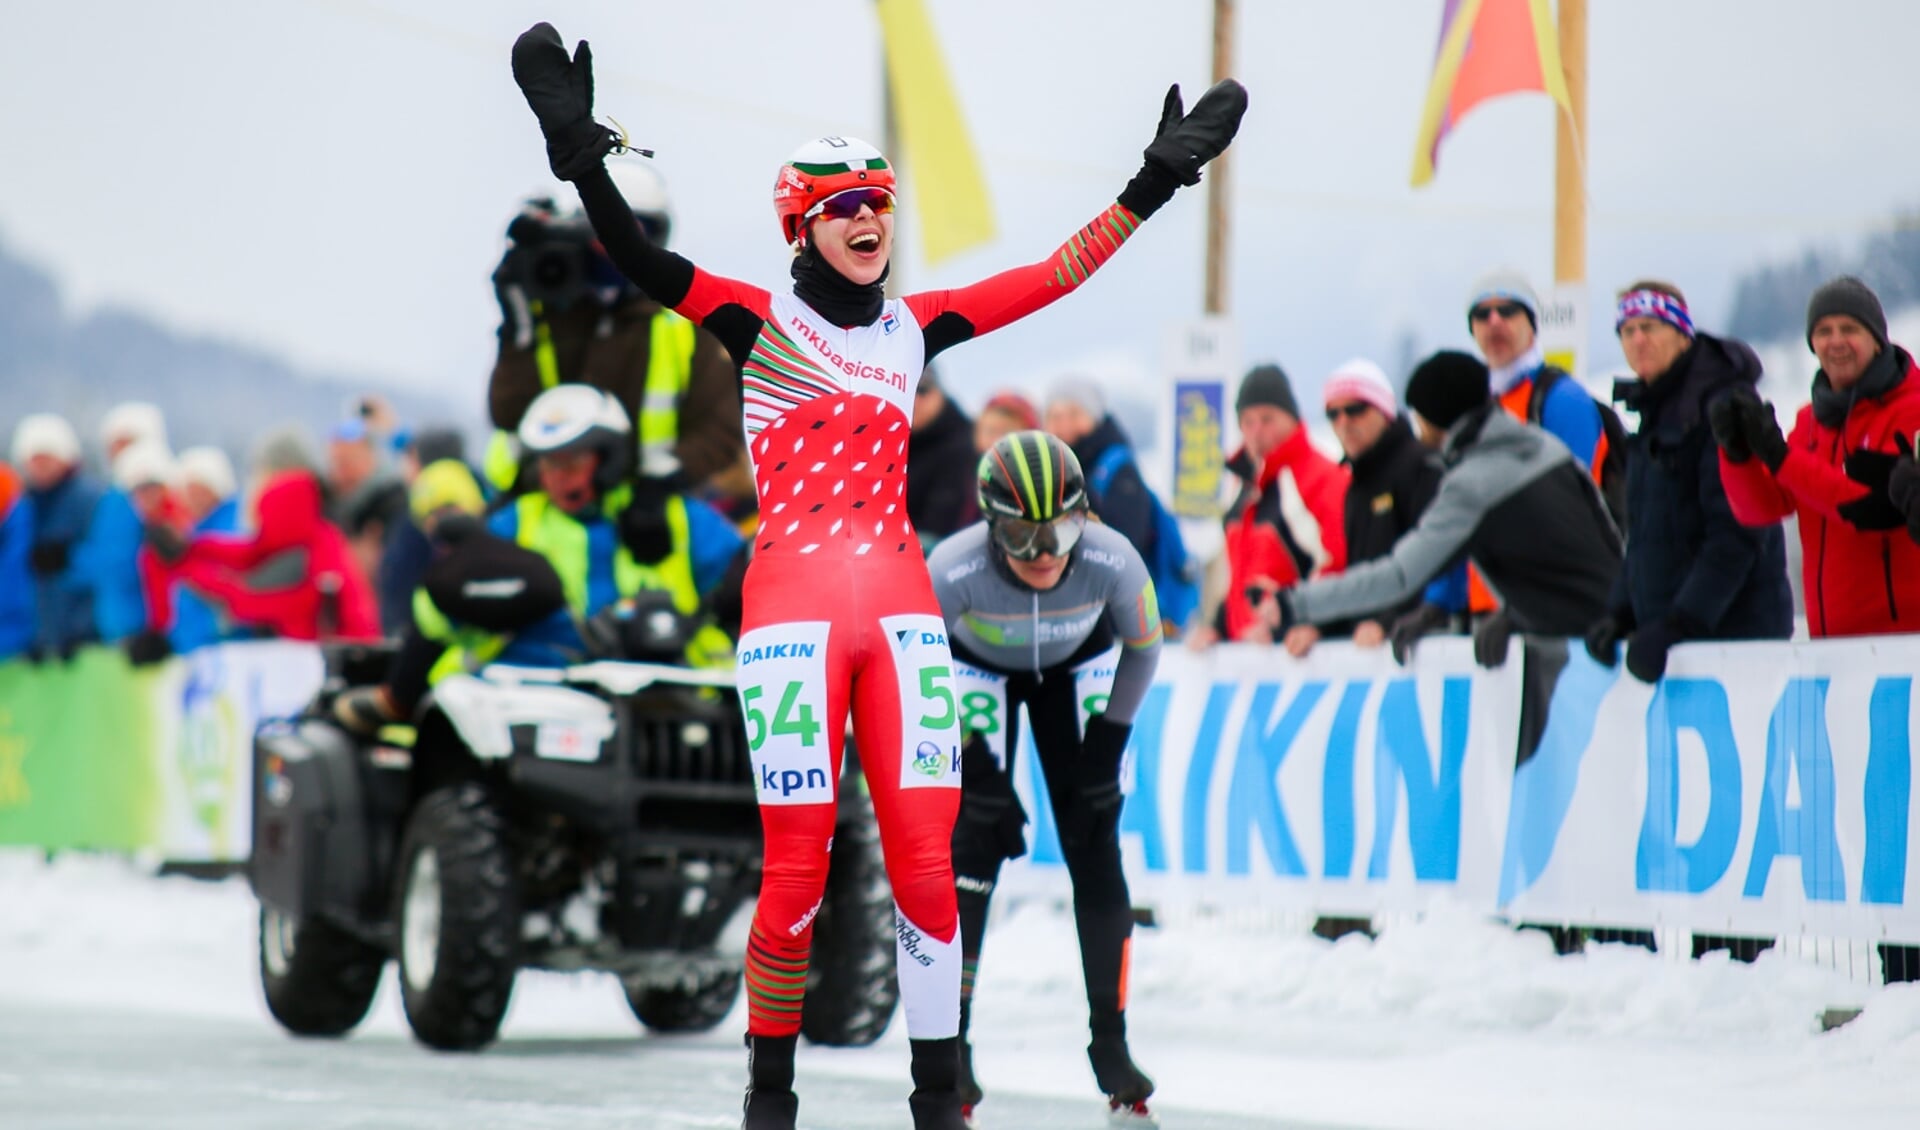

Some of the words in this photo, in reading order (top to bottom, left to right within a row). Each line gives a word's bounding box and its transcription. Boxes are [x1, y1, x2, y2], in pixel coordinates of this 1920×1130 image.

[791, 316, 907, 394] mkbasics.nl
[742, 643, 816, 666] DAIKIN
[743, 681, 820, 751] 54
[918, 665, 956, 730] 5
[762, 764, 826, 796] kpn
